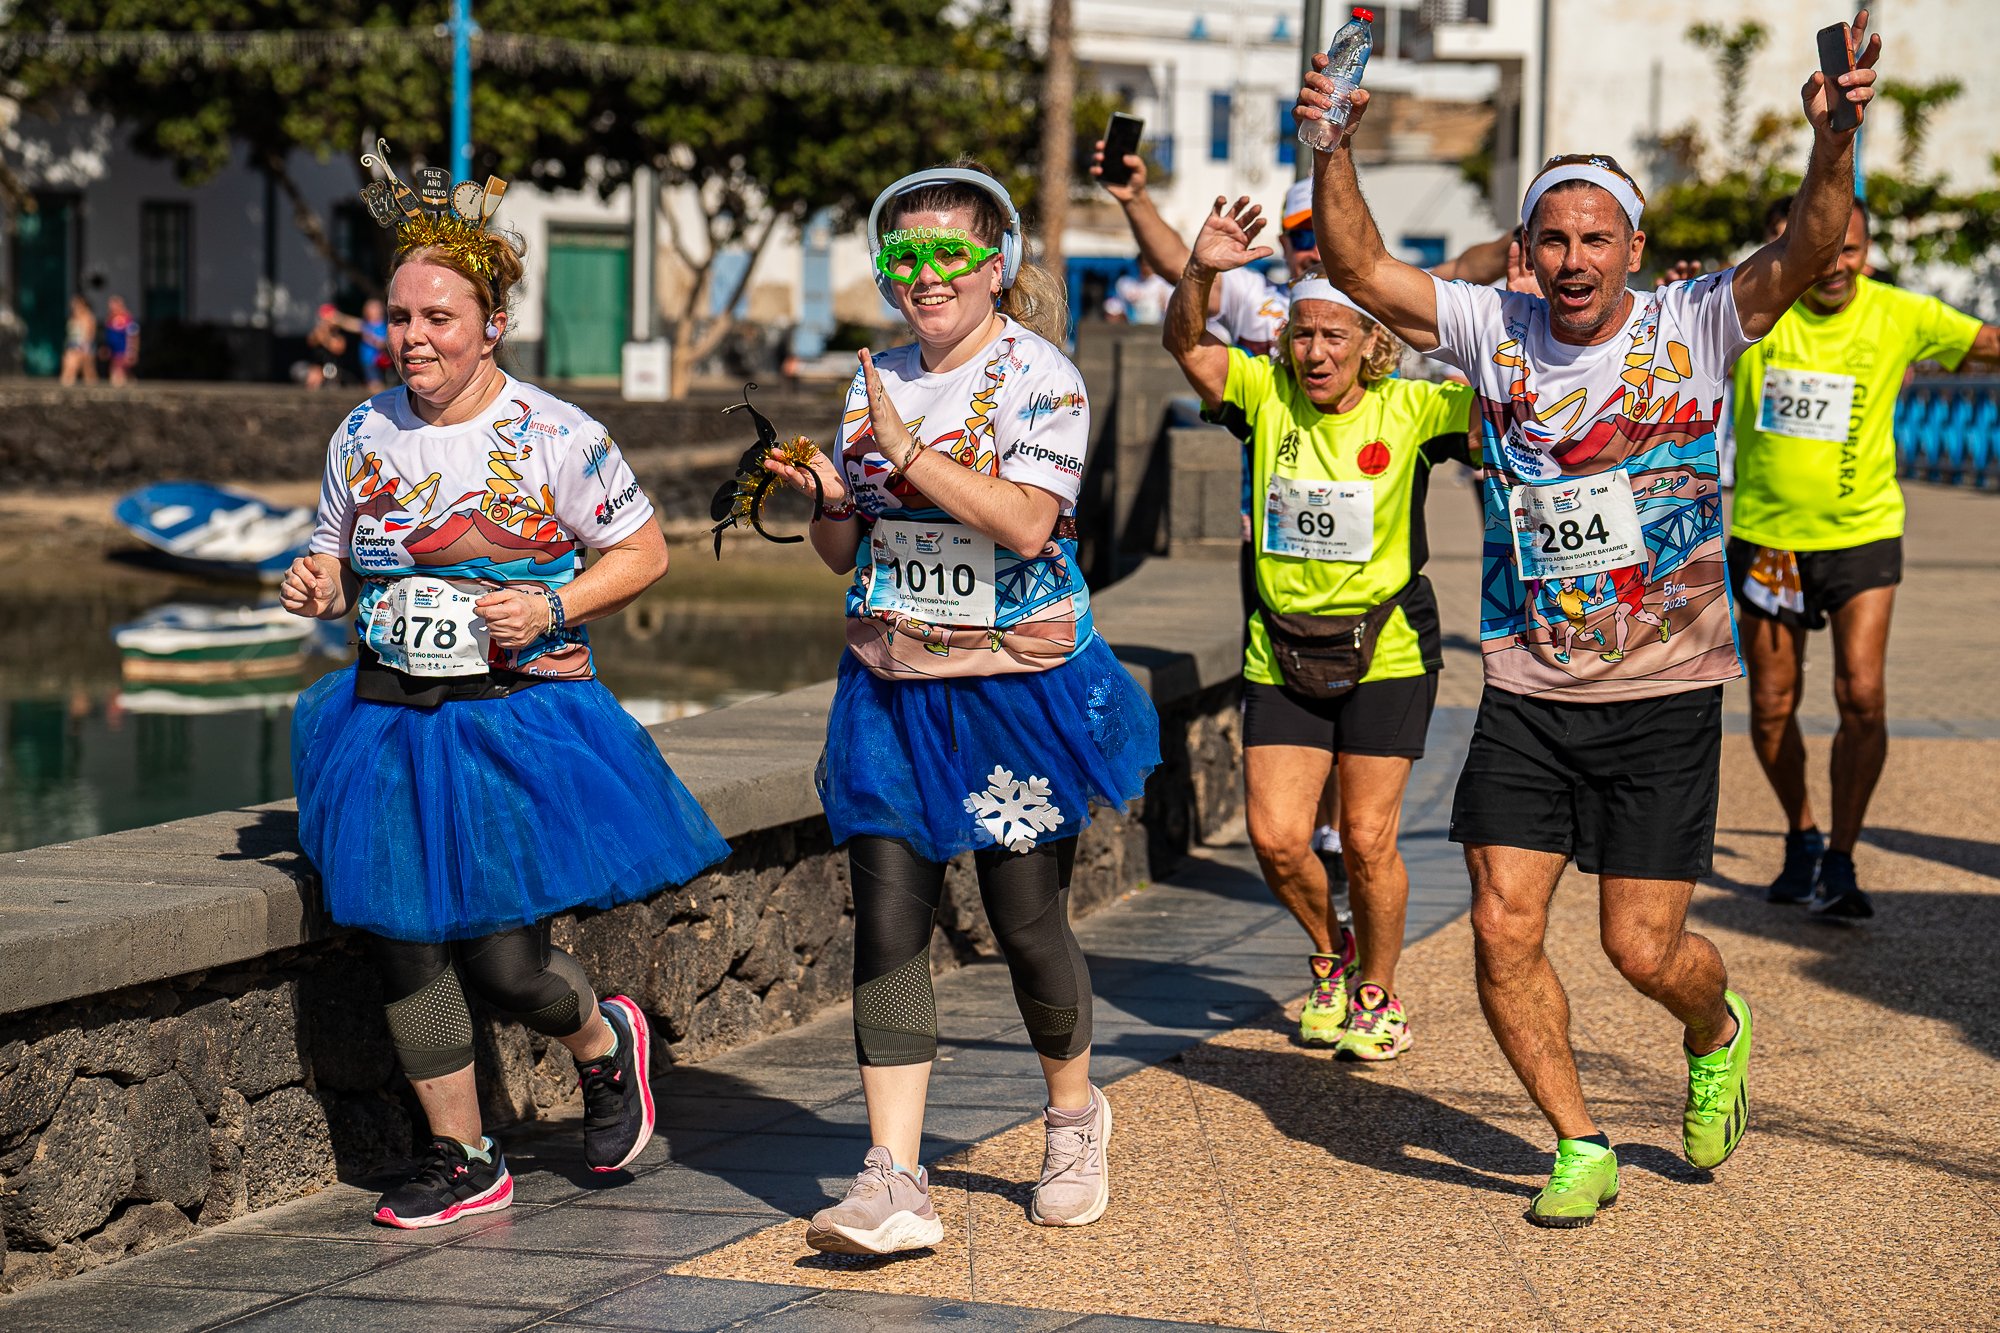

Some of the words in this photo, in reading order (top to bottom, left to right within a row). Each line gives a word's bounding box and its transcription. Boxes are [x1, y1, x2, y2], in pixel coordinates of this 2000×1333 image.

[423, 170, 442, 179] FELIZ
[426, 178, 441, 187] AÑO
[422, 188, 447, 198] NUEVO
[1780, 396, 1830, 420] 287
[528, 420, 558, 436] Arrecife
[1590, 488, 1597, 496] 5
[1297, 510, 1336, 538] 69
[356, 525, 375, 536] San
[1540, 513, 1610, 554] 284
[355, 536, 396, 547] Silvestre
[952, 536, 960, 545] 5
[355, 547, 391, 557] Ciudad
[359, 557, 400, 567] Arrecife
[888, 557, 976, 597] 1010
[452, 594, 458, 602] 5
[1662, 595, 1688, 612] 2025
[389, 615, 457, 650] 978
